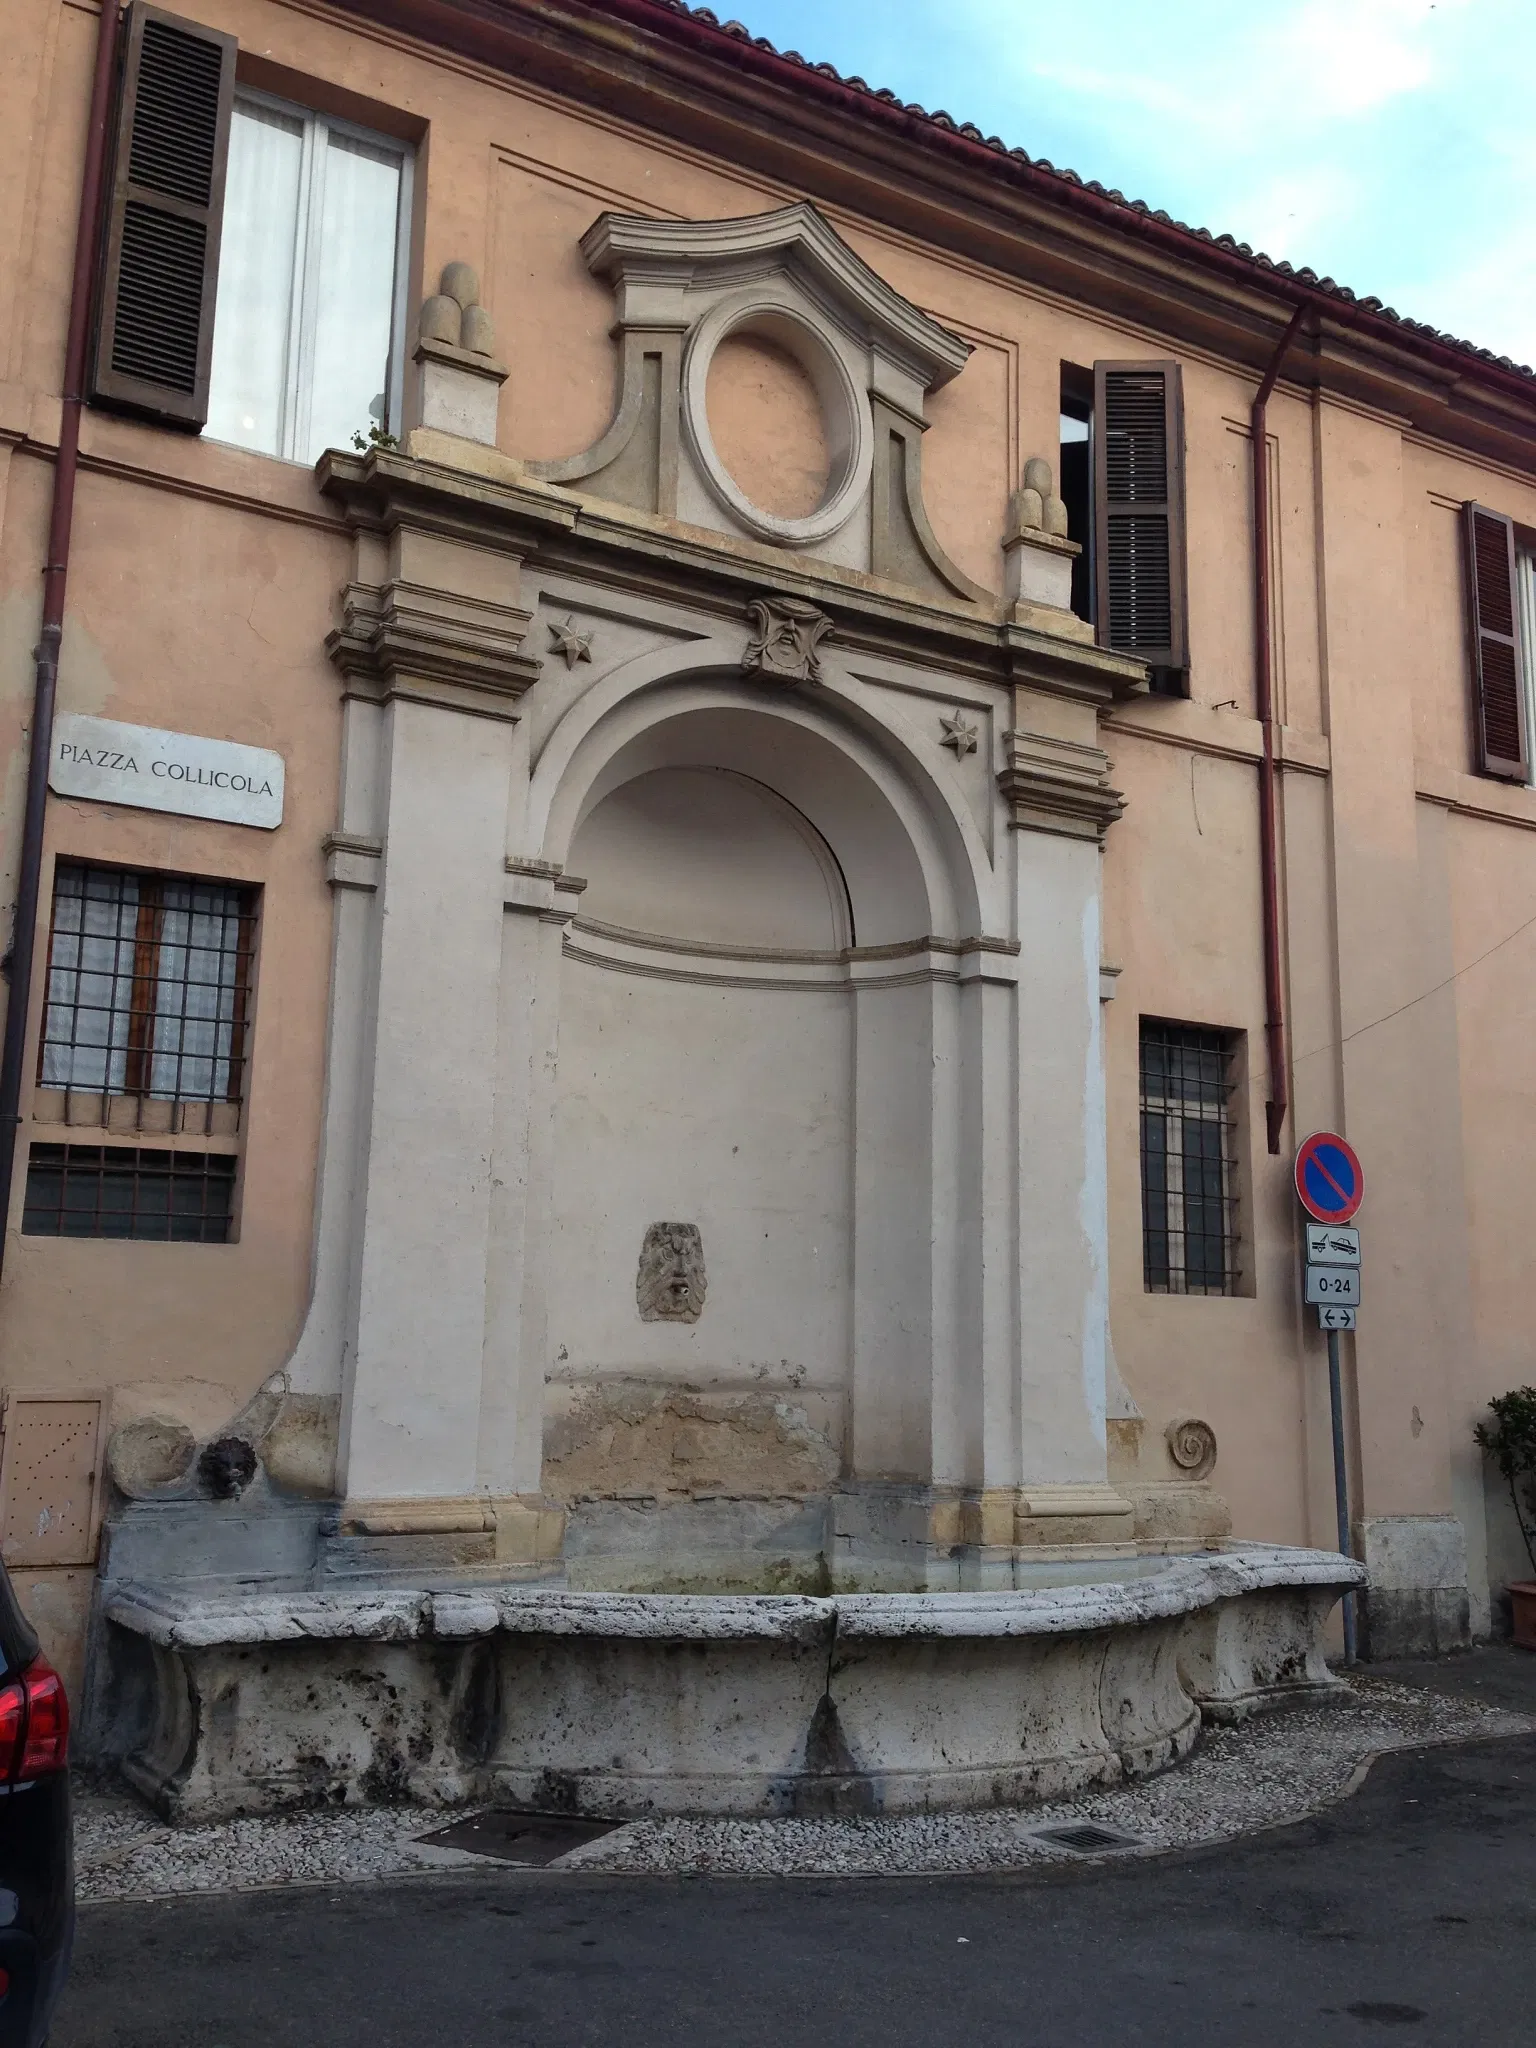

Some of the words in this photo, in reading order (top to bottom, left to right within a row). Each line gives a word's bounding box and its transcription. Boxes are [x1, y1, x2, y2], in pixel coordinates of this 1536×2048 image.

[60, 743, 139, 773] PIAZZA
[151, 761, 273, 797] COLLICOLA
[1319, 1278, 1351, 1293] 0-24
